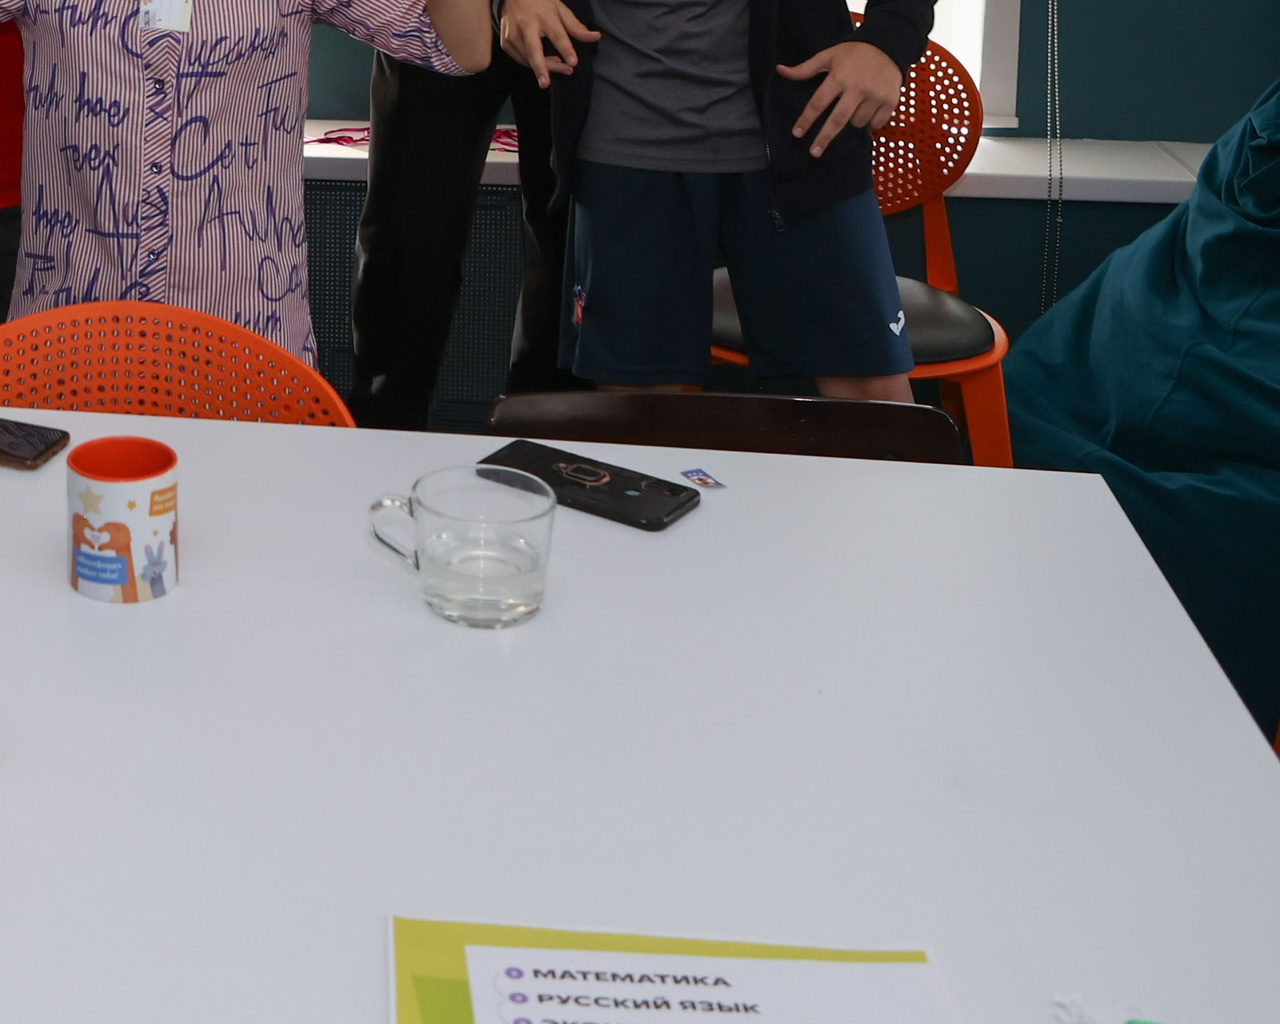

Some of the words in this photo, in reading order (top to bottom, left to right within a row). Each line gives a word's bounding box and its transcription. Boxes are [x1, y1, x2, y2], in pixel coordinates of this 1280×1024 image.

[532, 968, 732, 988] МАТЕМАТИКА
[536, 992, 671, 1011] РУССКИЙ
[678, 999, 762, 1015] ЯЗЫК
